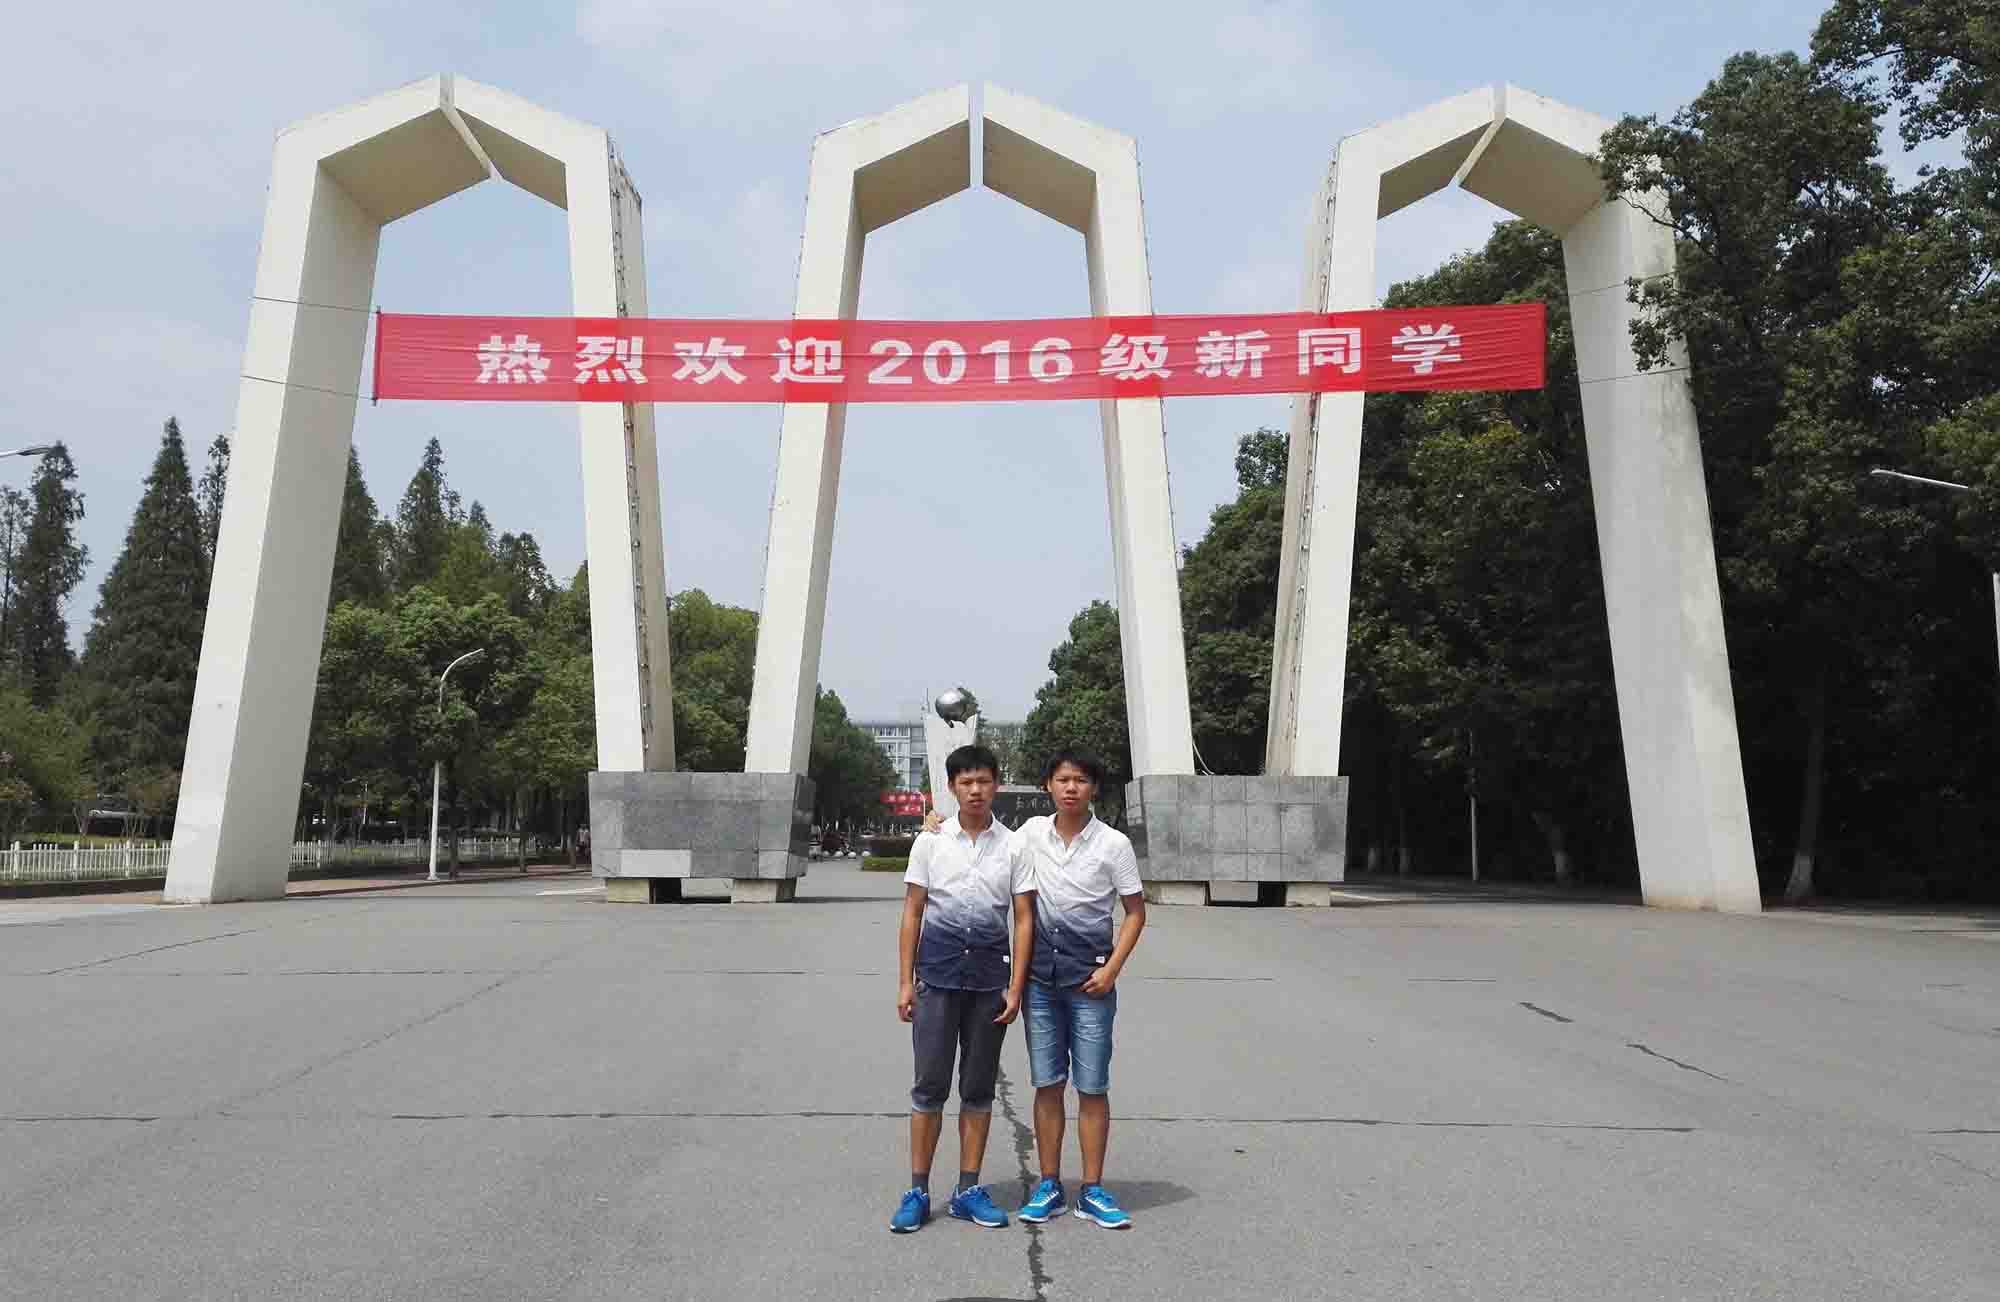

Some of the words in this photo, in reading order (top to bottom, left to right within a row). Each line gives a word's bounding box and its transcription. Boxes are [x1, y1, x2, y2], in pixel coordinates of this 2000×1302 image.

[474, 324, 1463, 385] 热烈欢迎2016级新同学
